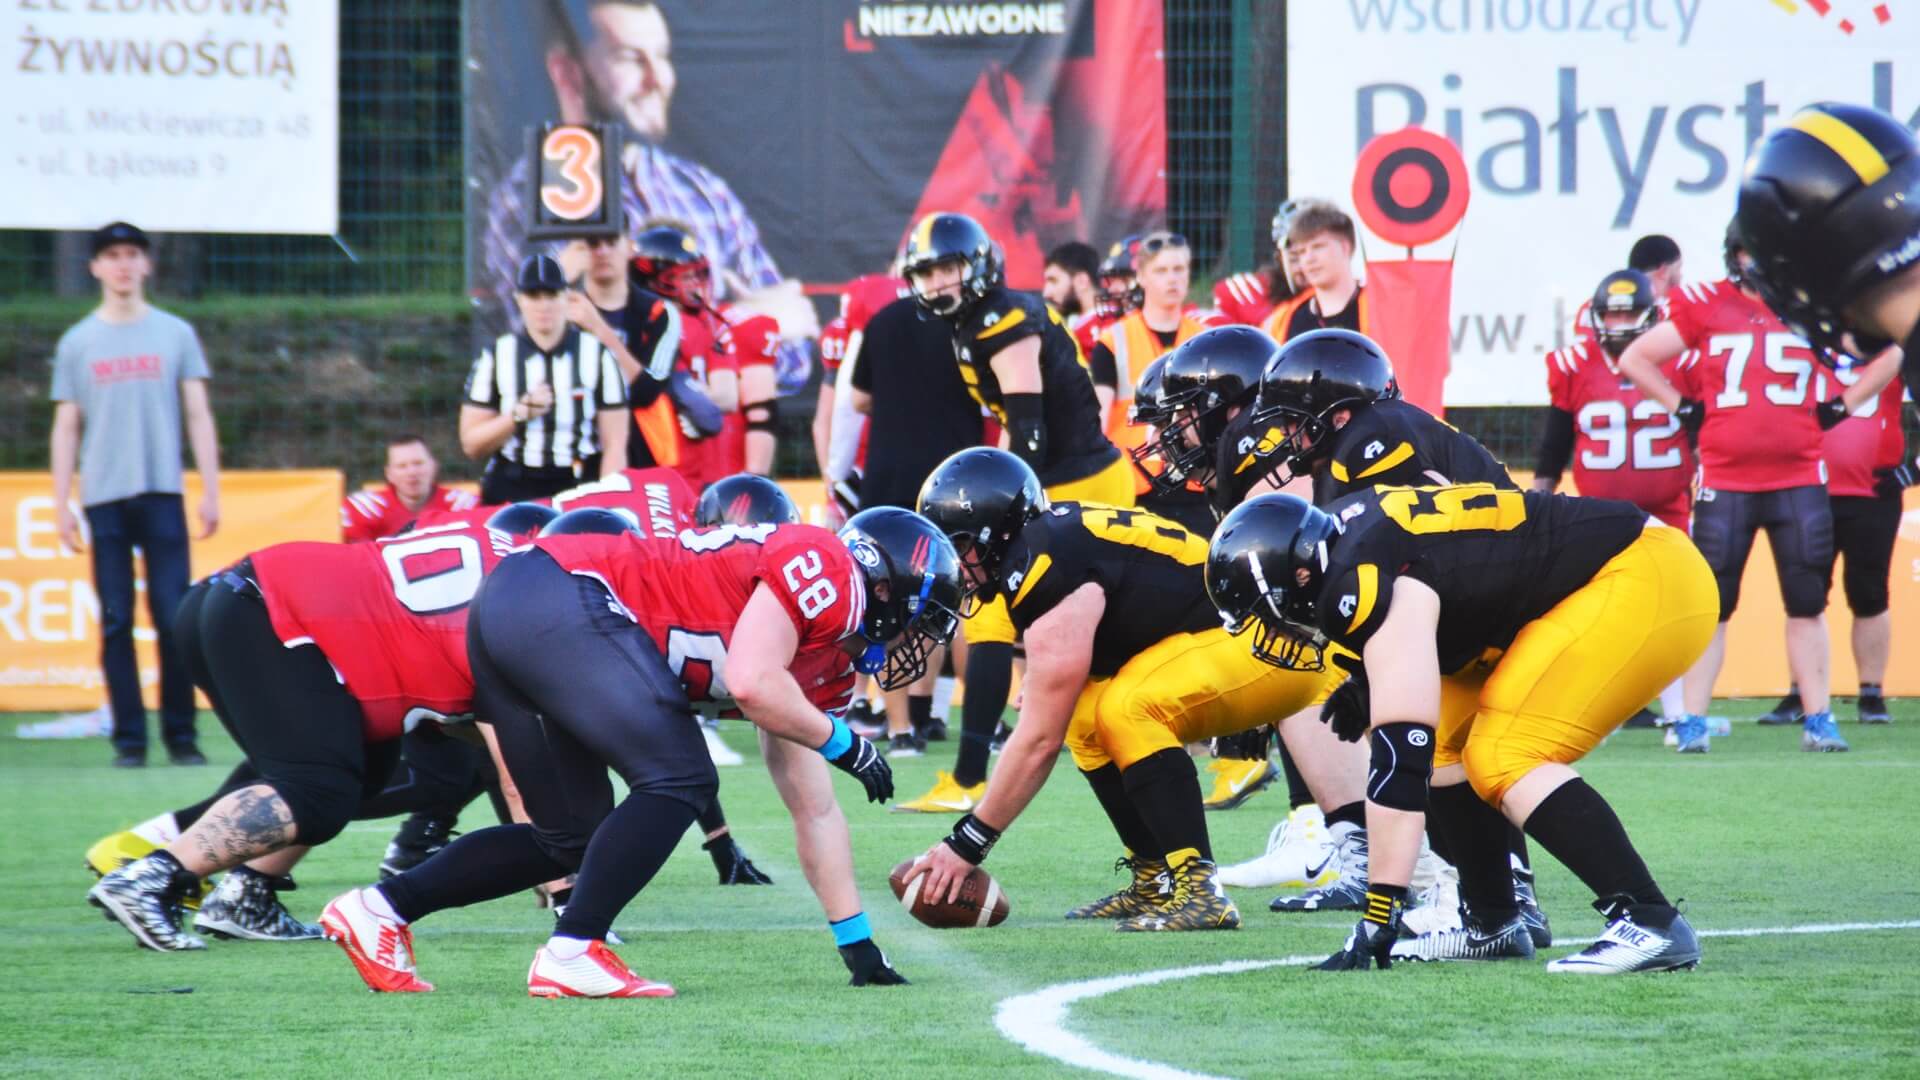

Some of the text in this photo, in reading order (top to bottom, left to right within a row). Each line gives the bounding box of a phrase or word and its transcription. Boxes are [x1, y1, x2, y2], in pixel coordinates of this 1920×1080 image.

[859, 3, 1066, 36] NIEZAWODNE
[16, 24, 297, 92] ŻYWNOŚCIĄ
[86, 106, 264, 138] Mickiewicza
[541, 126, 602, 220] 3
[1709, 332, 1813, 408] 75
[1577, 400, 1681, 470] 92
[644, 483, 676, 539] WILKI
[782, 550, 838, 620] 28
[376, 923, 397, 968] NIKE
[1612, 922, 1651, 948] NIKE
